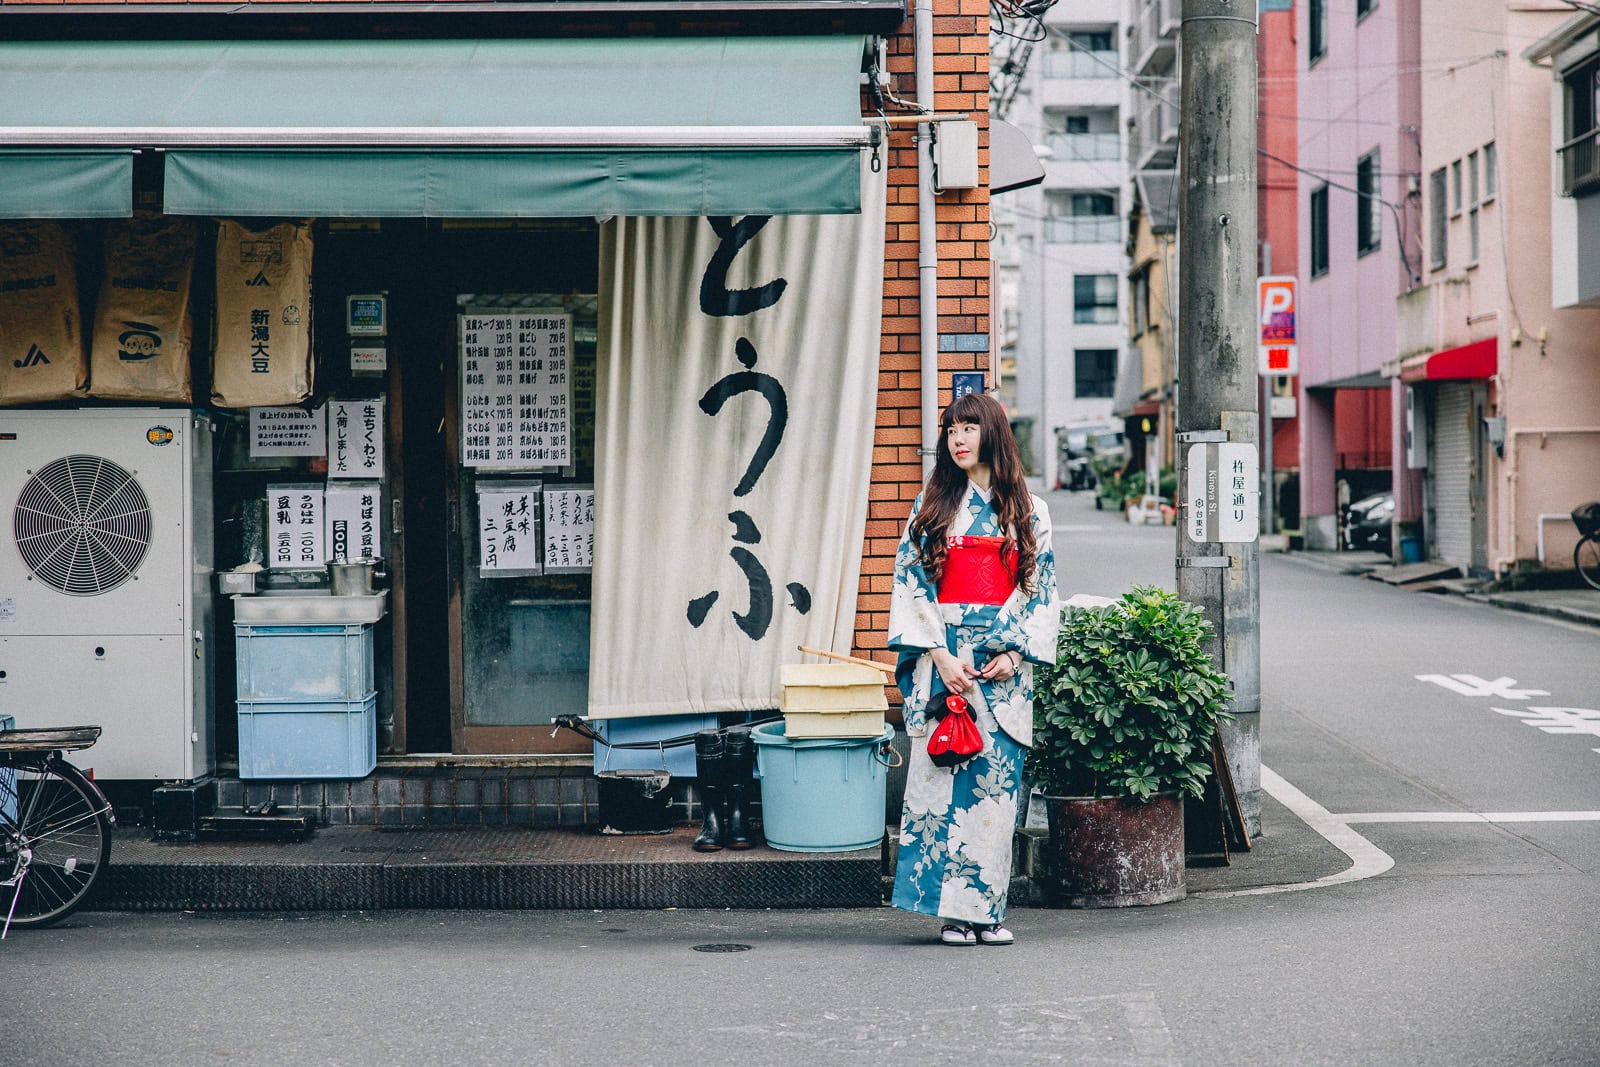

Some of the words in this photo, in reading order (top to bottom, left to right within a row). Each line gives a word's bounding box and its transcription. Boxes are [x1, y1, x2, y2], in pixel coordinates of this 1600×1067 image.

[1262, 287, 1292, 325] P
[251, 309, 270, 373] 新潟大豆
[467, 408, 495, 419] こんにゃく
[687, 215, 811, 641] とうふ
[337, 405, 347, 471] 入荷しました
[363, 405, 376, 468] 生ちくわぶ
[1208, 470, 1217, 500] Kineya
[1232, 460, 1245, 522] 杵屋通り
[277, 495, 291, 524] 豆乳
[361, 494, 374, 558] おぼろ豆腐
[517, 494, 530, 535] 美味
[1195, 510, 1203, 536] 台東区
[1208, 502, 1217, 515] St.
